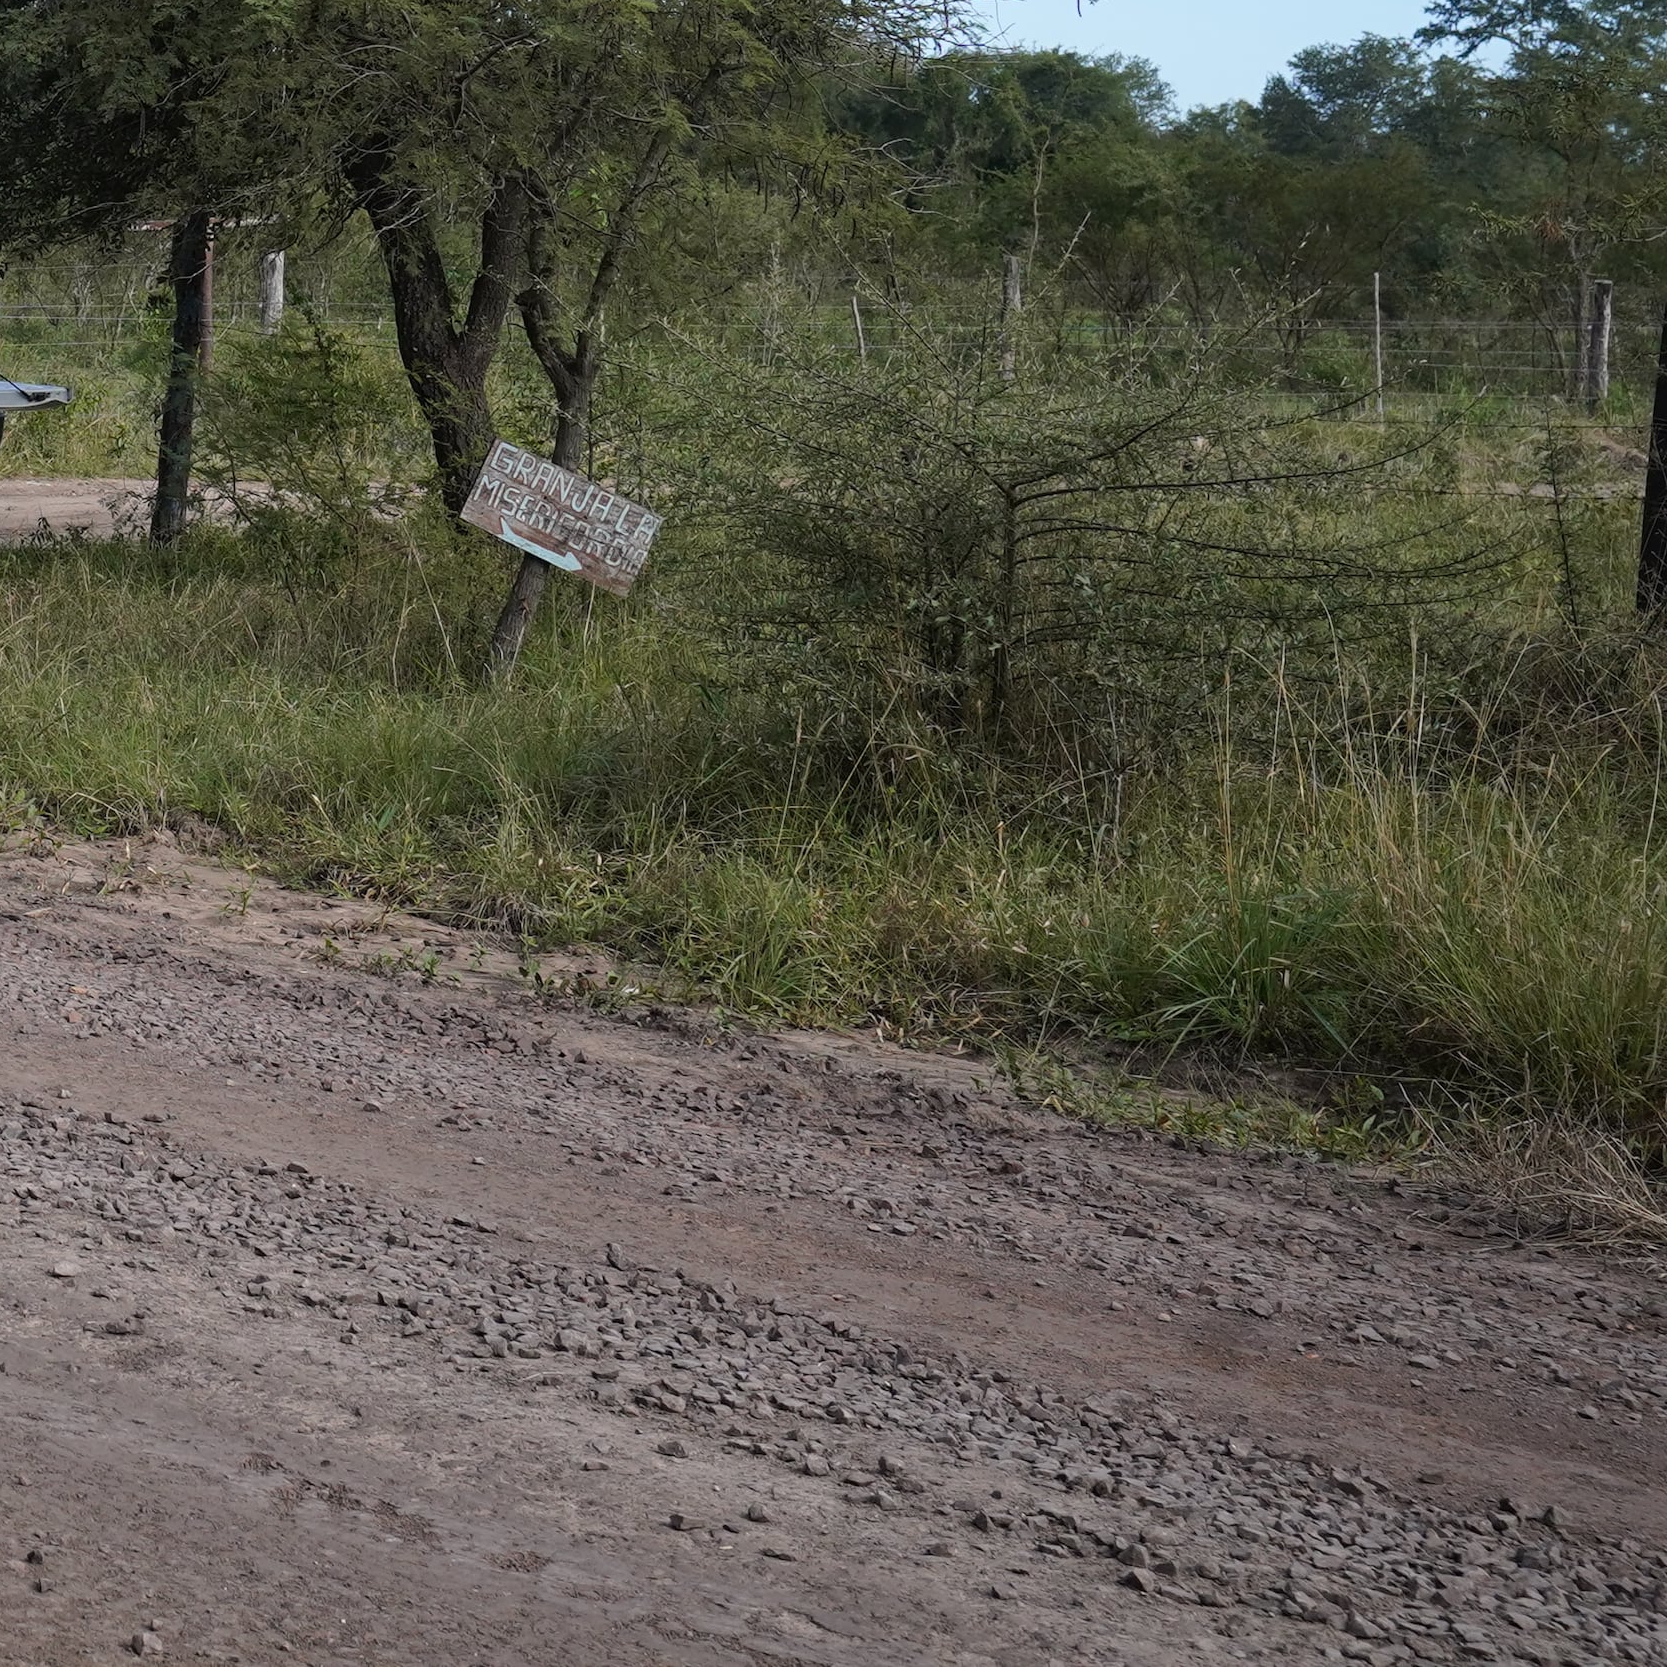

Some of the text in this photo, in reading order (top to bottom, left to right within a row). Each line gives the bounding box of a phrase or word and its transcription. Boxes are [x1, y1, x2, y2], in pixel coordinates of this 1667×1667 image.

[473, 474, 649, 576] MISERICORDIA
[490, 441, 660, 545] GRANJA LA
